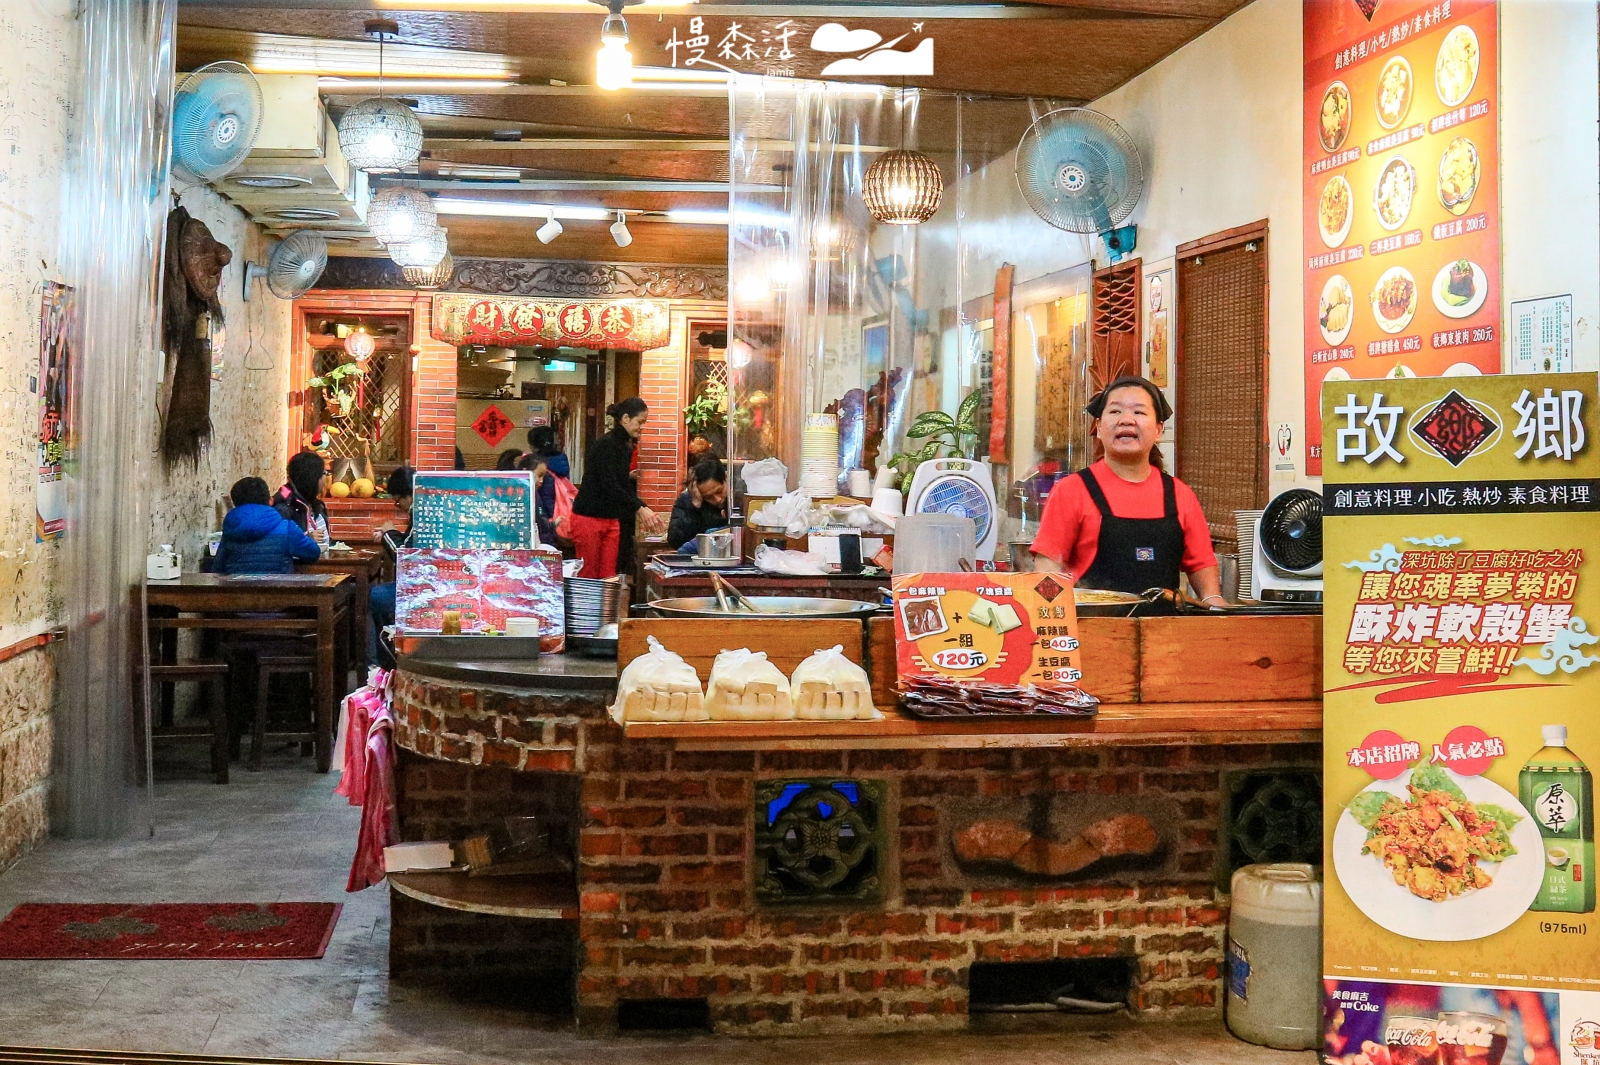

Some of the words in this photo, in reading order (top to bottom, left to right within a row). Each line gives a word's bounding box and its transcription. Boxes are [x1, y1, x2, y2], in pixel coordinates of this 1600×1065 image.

[1469, 99, 1488, 118] 120元
[1466, 214, 1487, 232] 200元
[1473, 326, 1493, 342] 260元
[1401, 551, 1583, 569] 深坑除了豆腐好吃之外
[1360, 572, 1578, 600] 讓您魂牽夢縈的
[1347, 603, 1573, 643] 酥炸軟殼蟹
[944, 633, 974, 648] 一組
[937, 651, 984, 666] 120元
[1038, 657, 1071, 668] 生豆腐
[1348, 742, 1420, 767] 本店招牌
[1430, 738, 1505, 764] 人氣必點
[1541, 783, 1567, 834] 原萃
[1539, 921, 1587, 936] (975ml)
